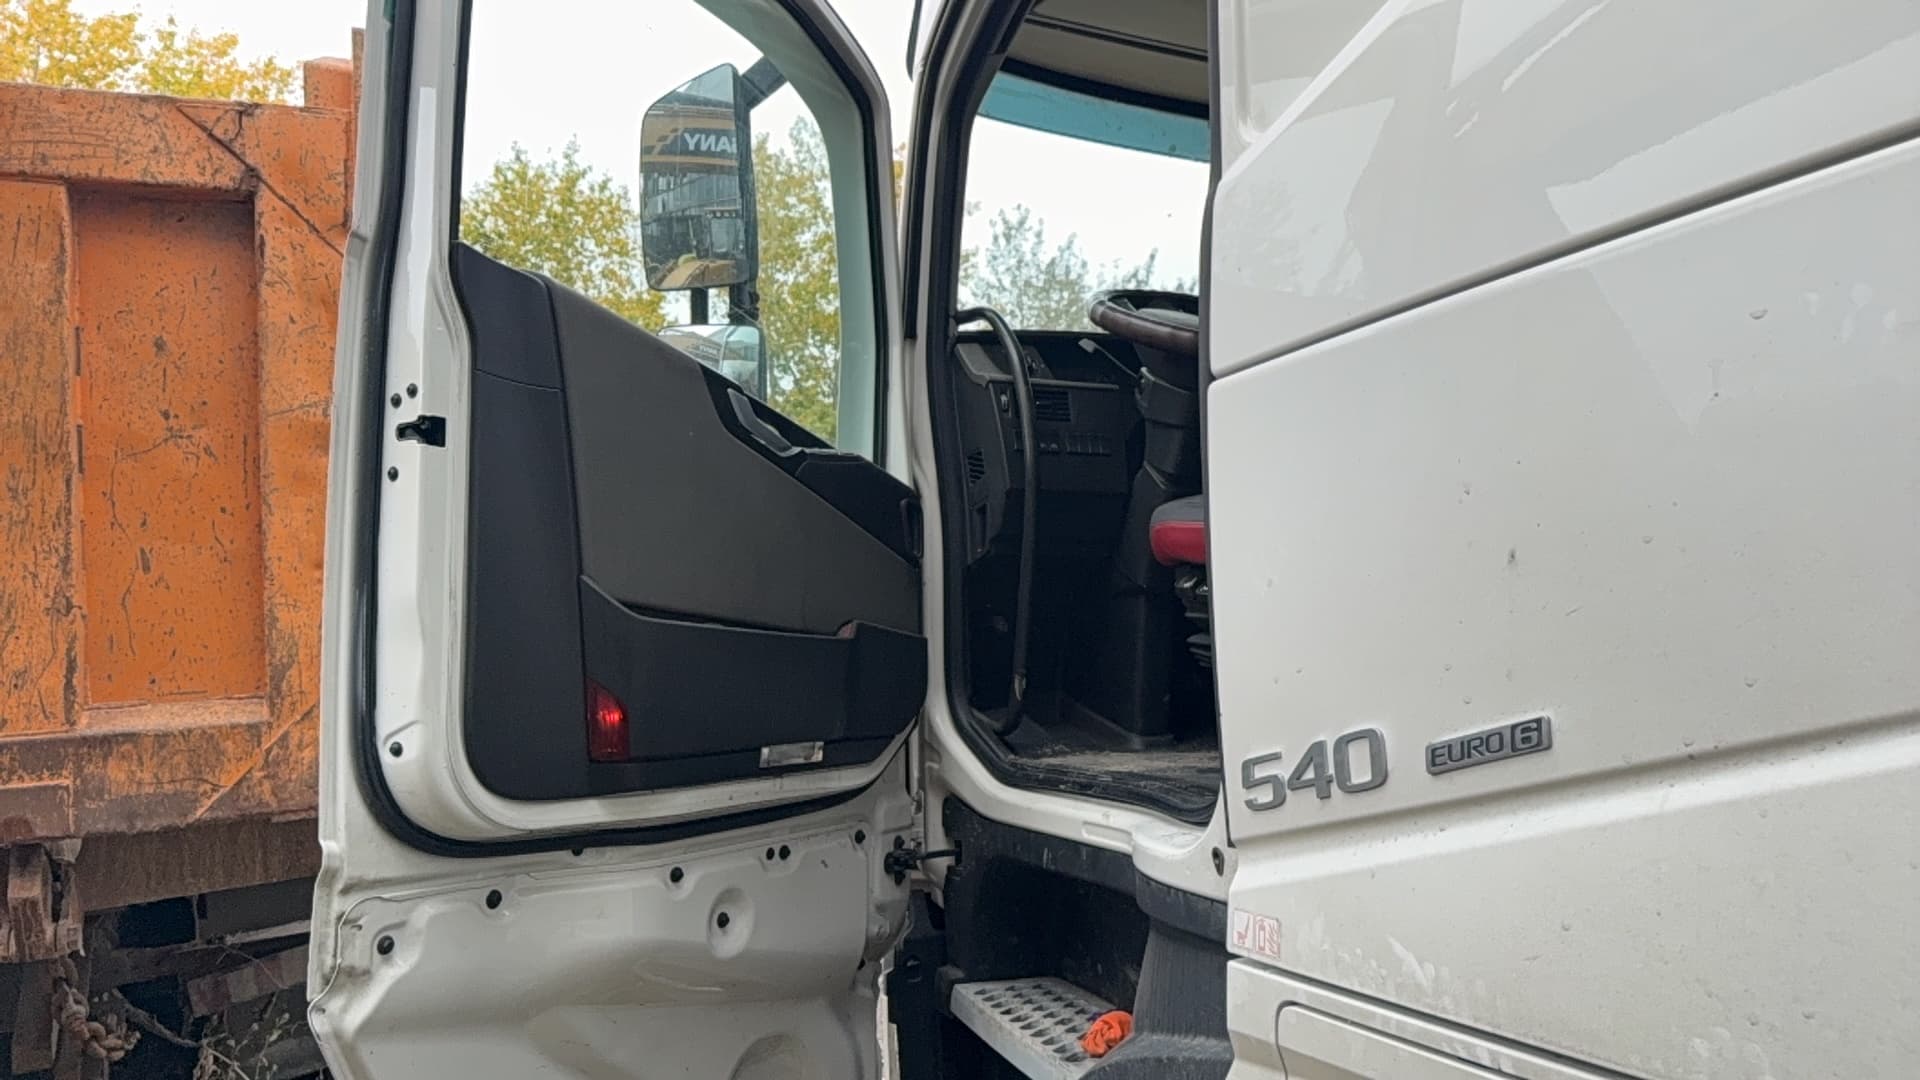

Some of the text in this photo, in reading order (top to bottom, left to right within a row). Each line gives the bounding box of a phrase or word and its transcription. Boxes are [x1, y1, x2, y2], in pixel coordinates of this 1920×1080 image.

[1241, 728, 1388, 812] 540
[1430, 720, 1540, 768] EURO 6
